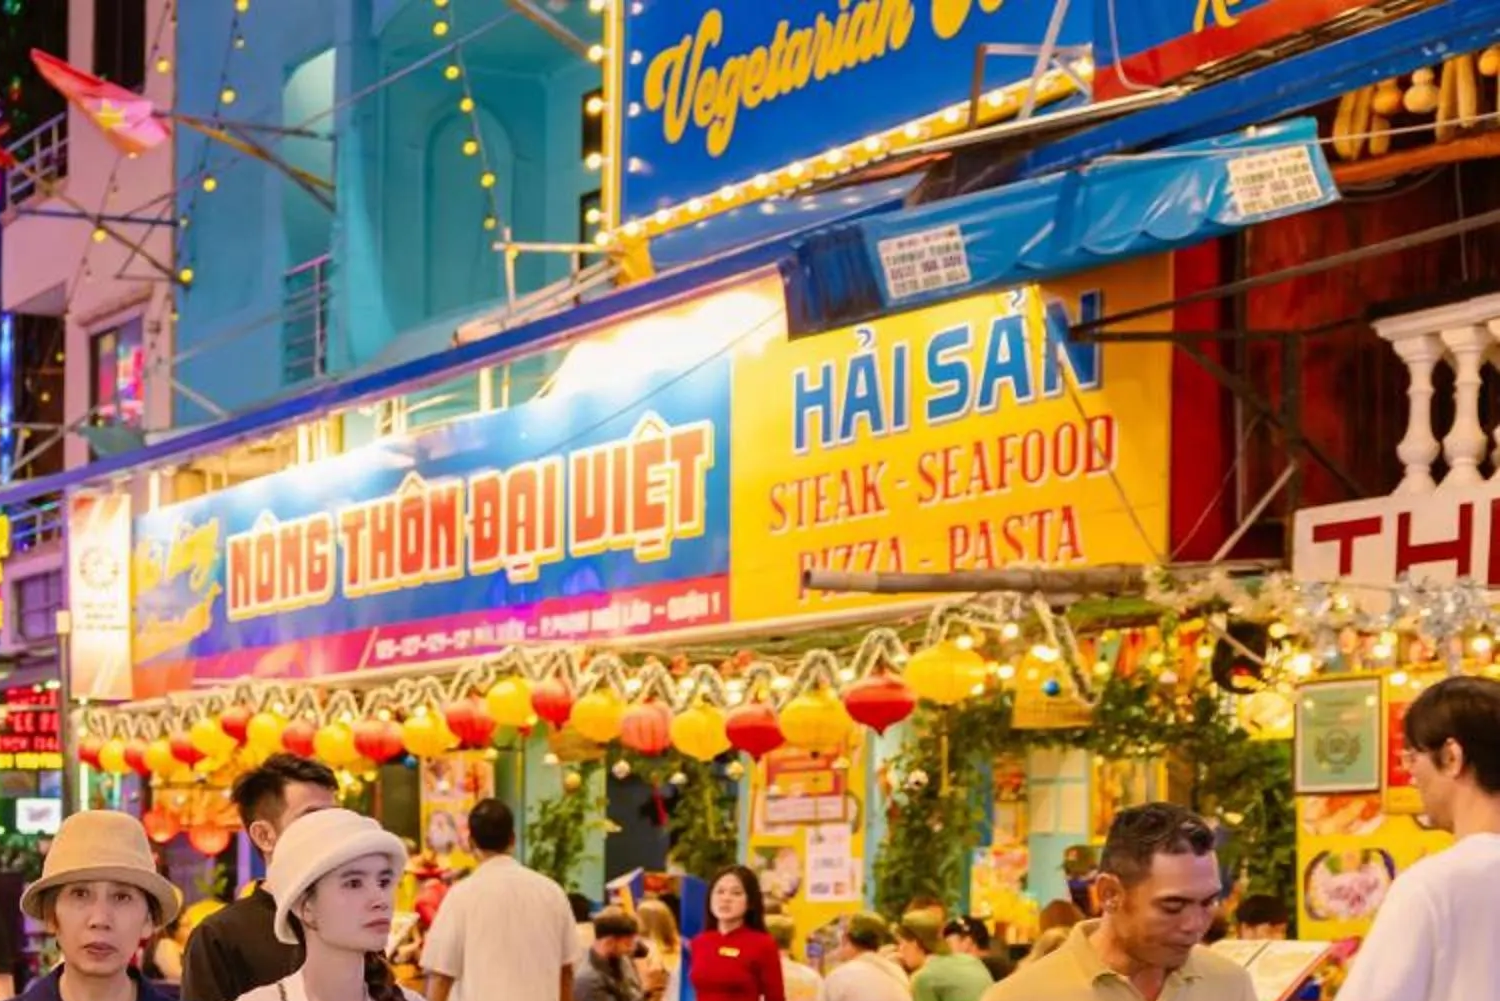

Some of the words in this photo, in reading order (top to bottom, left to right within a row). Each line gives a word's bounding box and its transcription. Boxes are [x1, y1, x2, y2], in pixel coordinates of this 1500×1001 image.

[644, 0, 915, 157] Vegetarian
[791, 326, 911, 455] HẢI
[925, 288, 1105, 425] SẢN
[226, 510, 337, 622] NÔNG
[338, 471, 466, 598] THÔN
[465, 454, 566, 583] ĐẠI
[769, 460, 888, 535] STEAK
[917, 414, 1119, 507] SEAFOOD
[1313, 498, 1500, 589] TH
[796, 536, 912, 601] PIZZA
[948, 505, 1087, 574] PASTA
